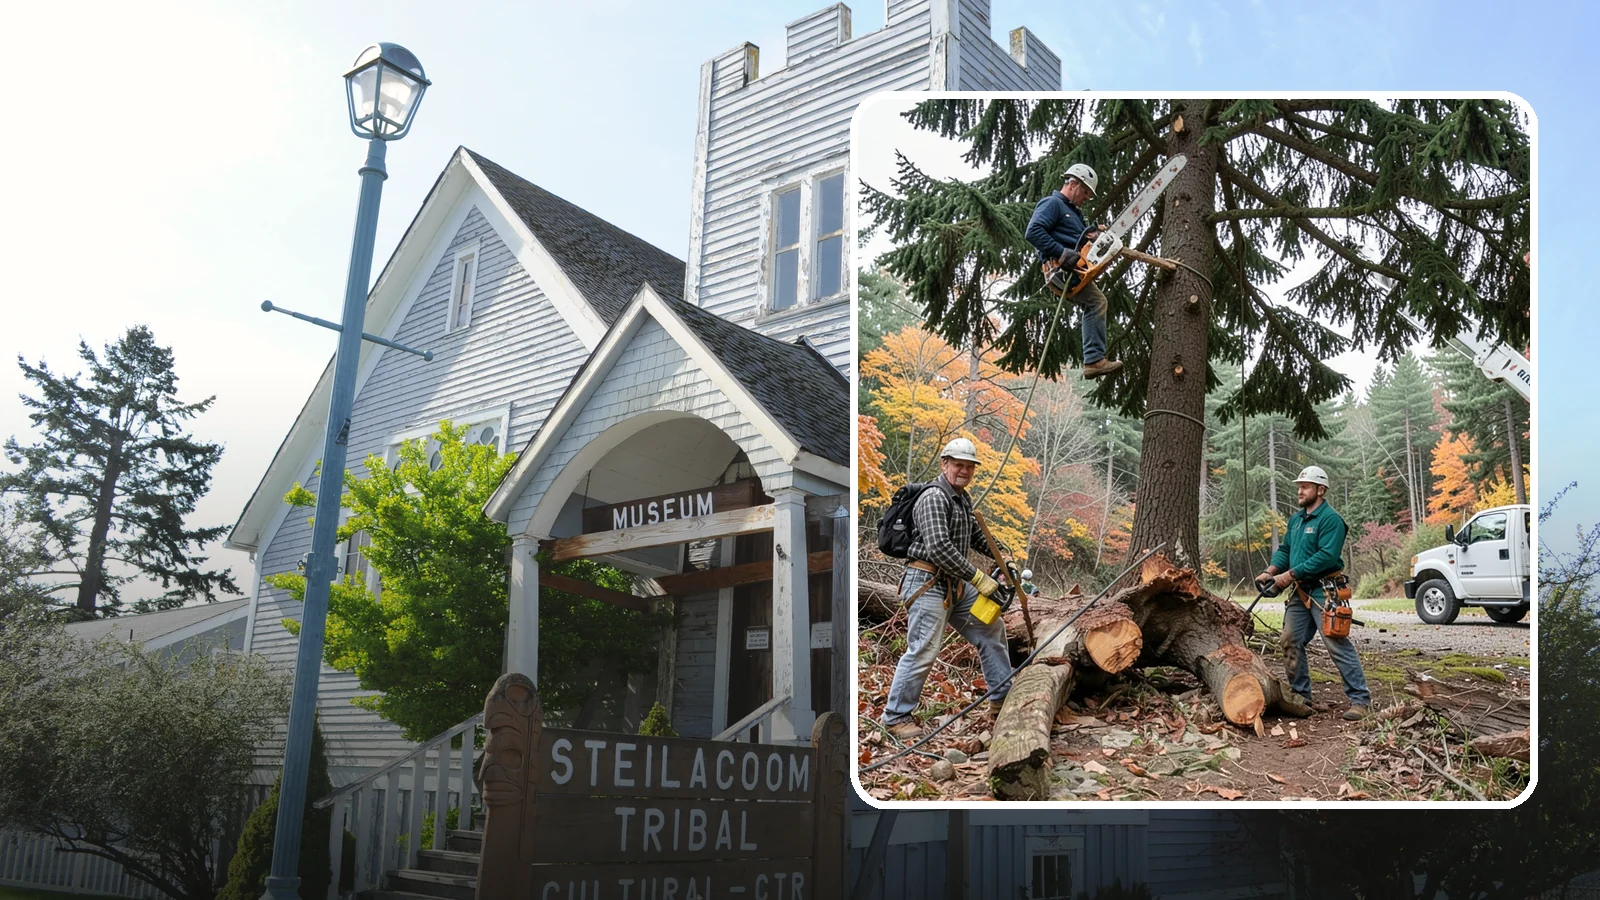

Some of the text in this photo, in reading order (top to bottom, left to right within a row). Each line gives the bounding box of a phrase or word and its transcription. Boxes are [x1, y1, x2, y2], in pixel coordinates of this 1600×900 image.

[613, 491, 714, 530] MUSEUM
[551, 738, 810, 793] STEILACOOM
[615, 806, 758, 852] TRIBAL
